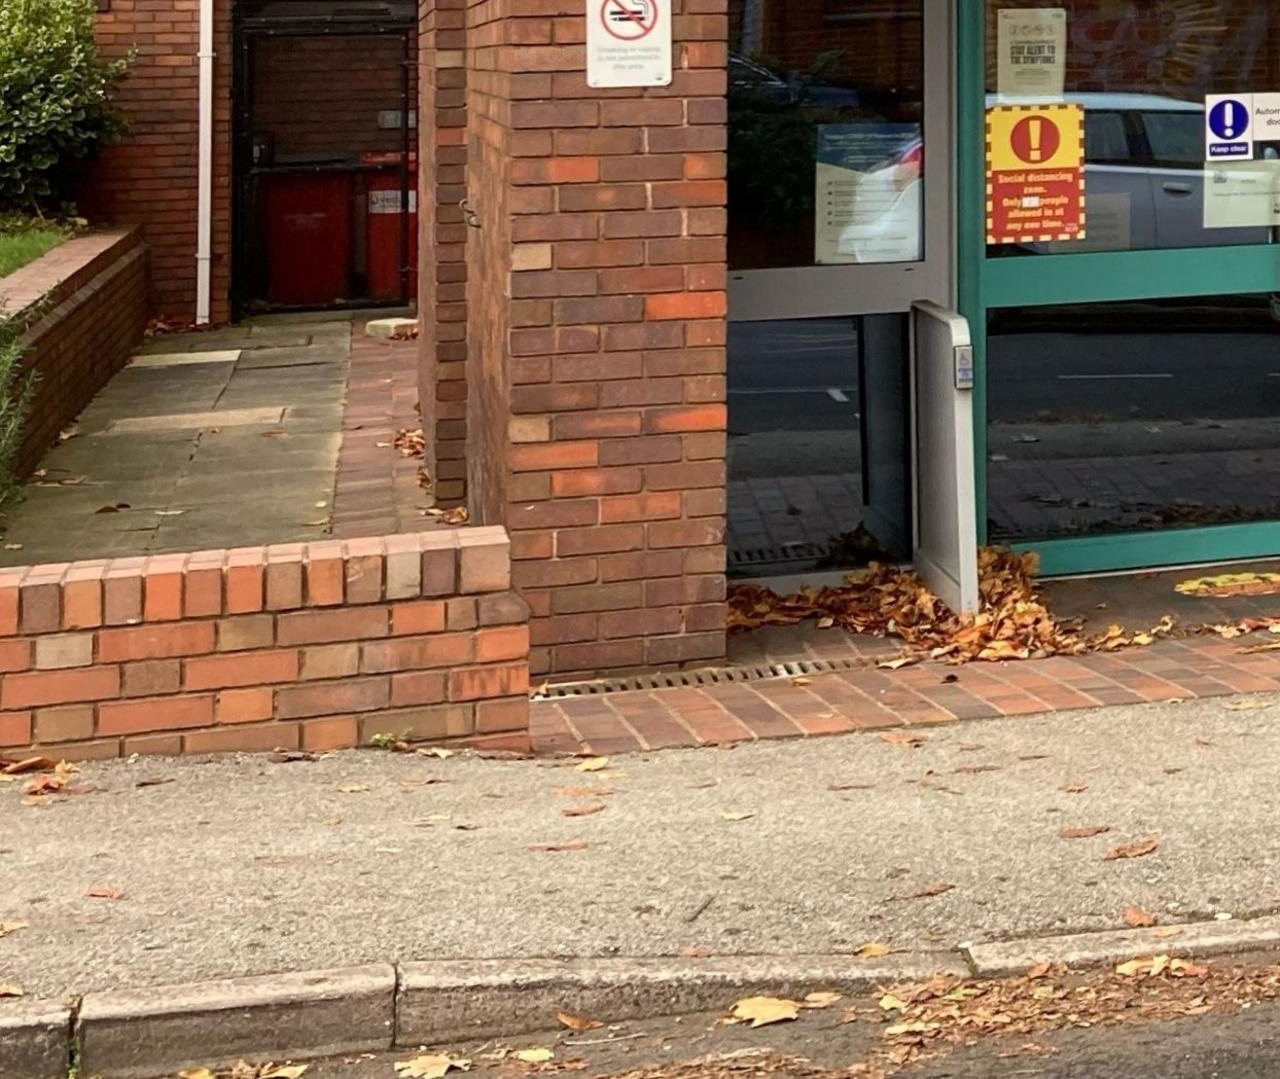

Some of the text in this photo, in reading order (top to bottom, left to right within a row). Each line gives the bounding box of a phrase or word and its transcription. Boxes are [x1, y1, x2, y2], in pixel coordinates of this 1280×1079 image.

[998, 172, 1073, 183] Social distancing
[1024, 186, 1048, 194] zone.
[1002, 195, 1069, 208] Only people
[1008, 207, 1064, 218] allowed in at
[1006, 223, 1022, 231] any
[1042, 220, 1065, 228] time.
